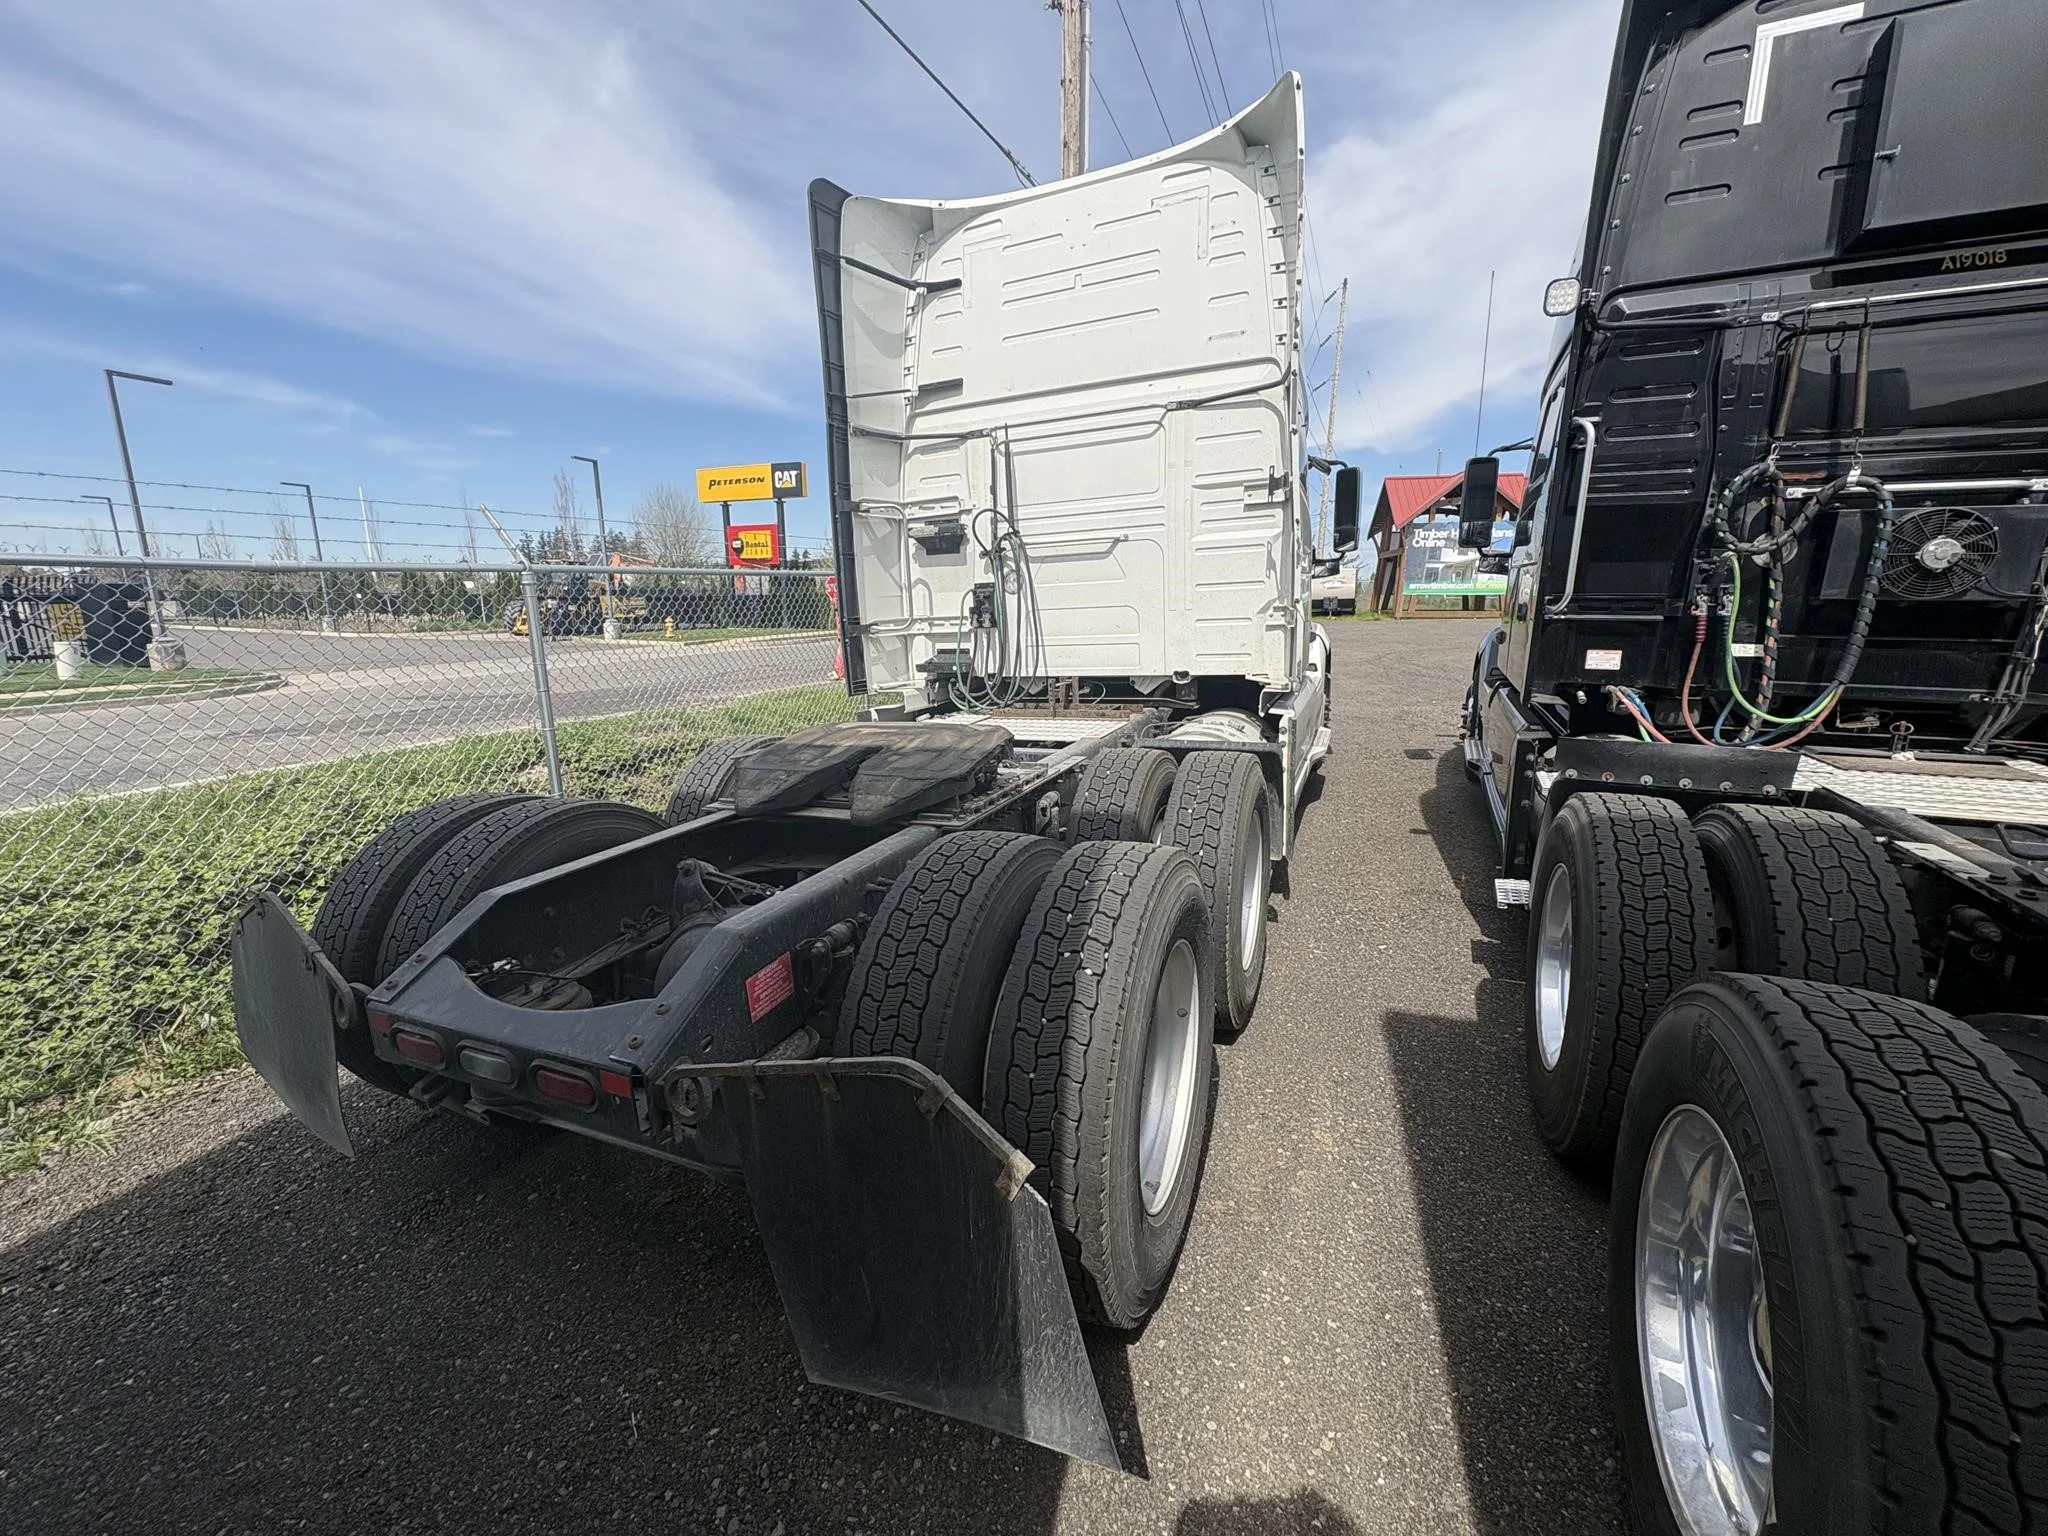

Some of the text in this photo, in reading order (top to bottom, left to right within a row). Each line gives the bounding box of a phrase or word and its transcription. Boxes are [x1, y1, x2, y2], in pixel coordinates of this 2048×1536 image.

[1941, 248, 2008, 271] A19018
[708, 476, 766, 490] PETERSON
[774, 470, 798, 489] CAT
[1413, 528, 1449, 539] Timber
[1492, 527, 1514, 538] lans
[745, 541, 769, 549] Rental
[1412, 537, 1446, 548] Online
